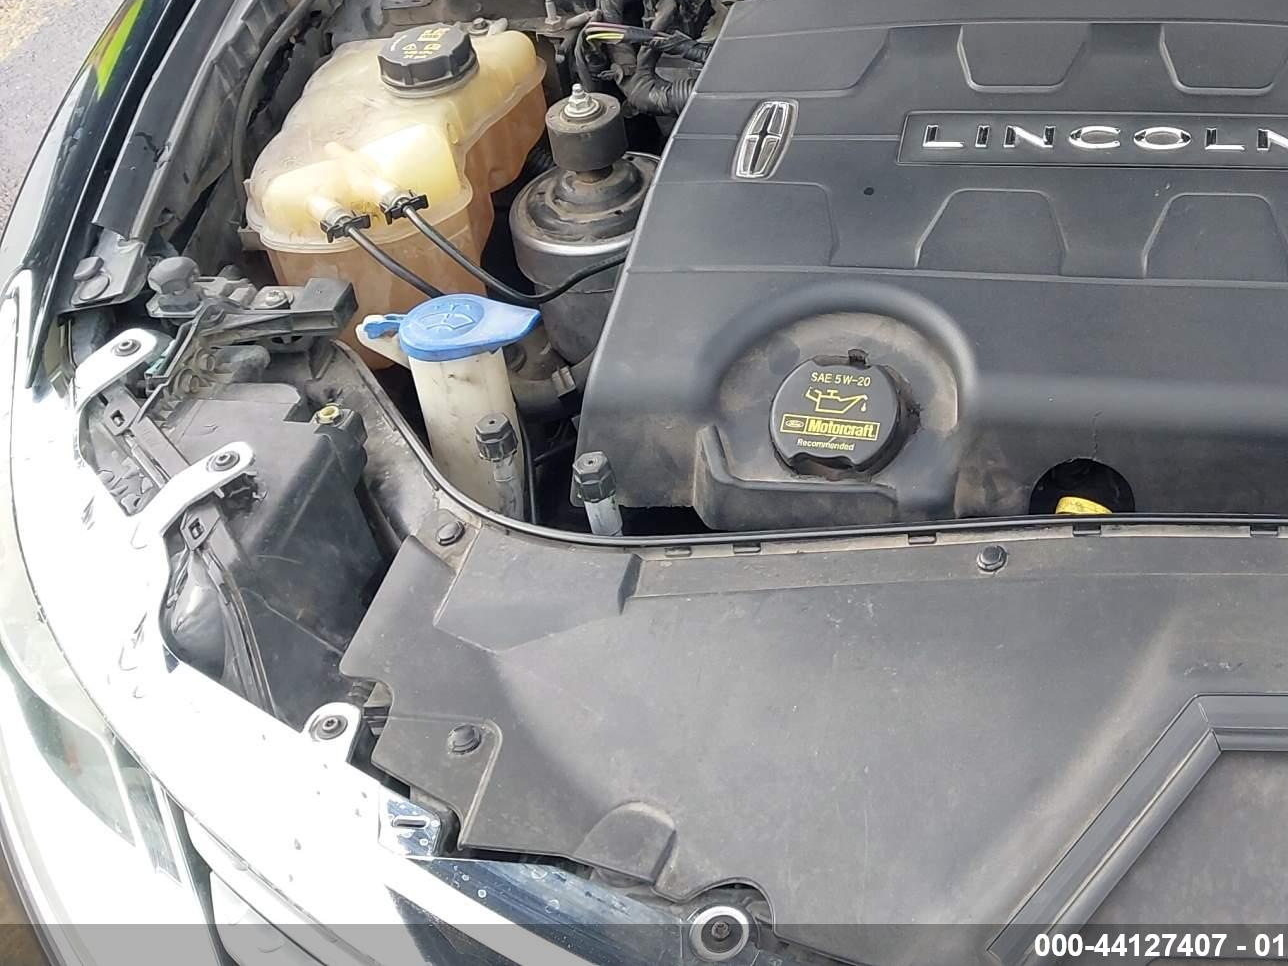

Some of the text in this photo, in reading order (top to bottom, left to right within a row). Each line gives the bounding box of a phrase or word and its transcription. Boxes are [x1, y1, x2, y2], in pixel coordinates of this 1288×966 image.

[811, 372, 871, 387] SAE 5W-20
[807, 419, 875, 438] Motorcraft
[797, 438, 855, 451] Recommended
